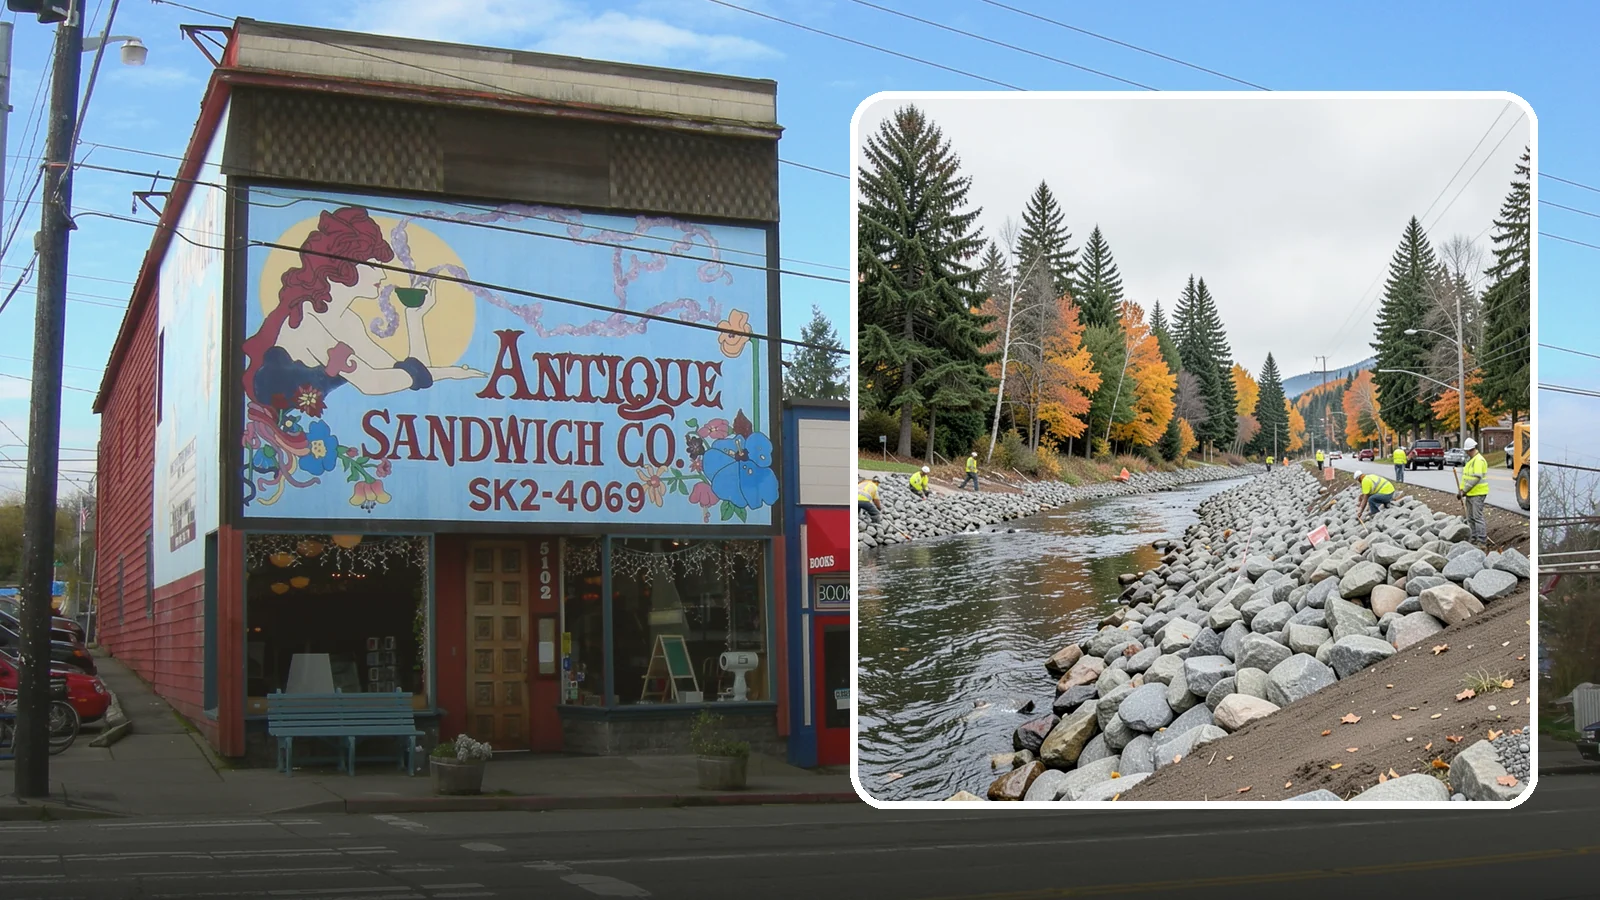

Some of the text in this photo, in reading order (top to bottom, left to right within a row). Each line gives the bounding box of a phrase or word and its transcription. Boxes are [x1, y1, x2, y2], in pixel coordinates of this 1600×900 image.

[476, 329, 724, 421] ANTIQUE
[361, 408, 684, 468] SANDWICH CO.
[470, 477, 646, 513] SK2-4069
[540, 541, 552, 599] 5102
[809, 555, 835, 569] BOOKS
